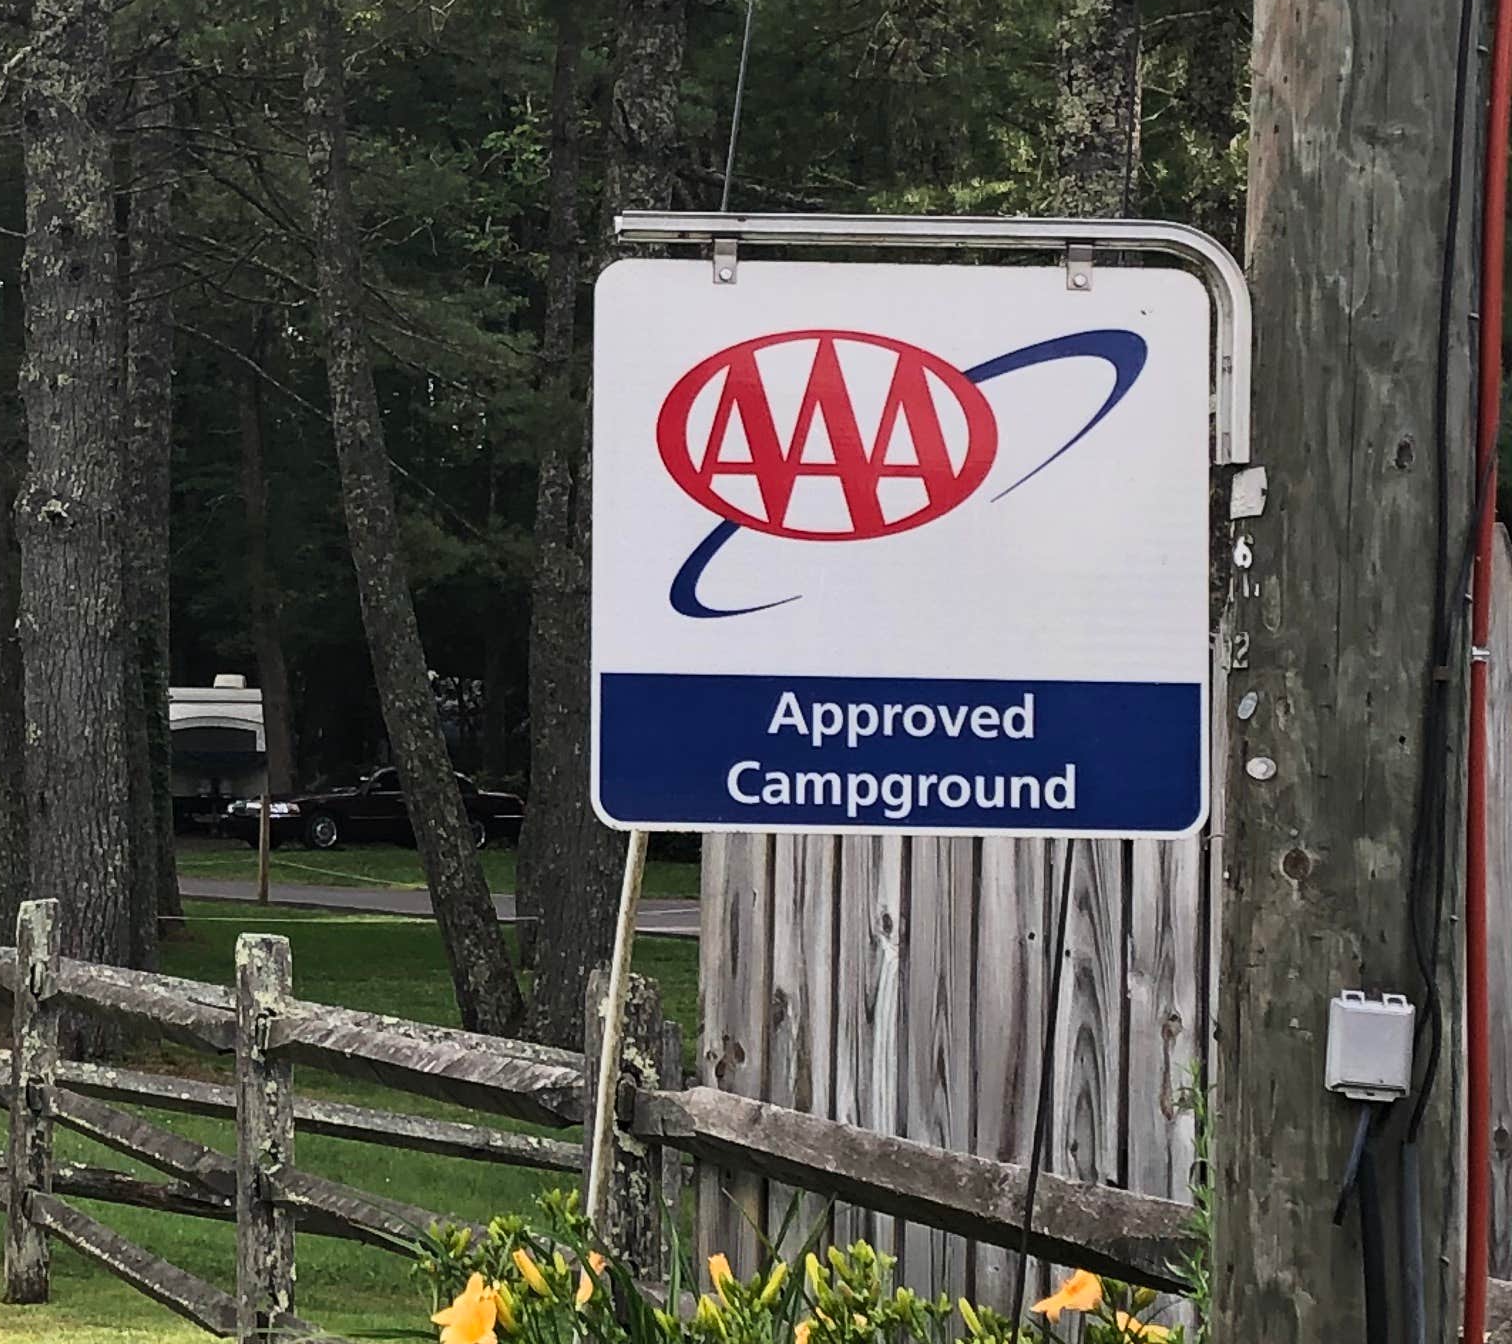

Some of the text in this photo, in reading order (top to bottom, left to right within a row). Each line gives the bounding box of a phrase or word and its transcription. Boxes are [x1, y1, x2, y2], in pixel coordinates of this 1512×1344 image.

[678, 331, 973, 538] AAA
[1234, 534, 1254, 569] 6
[1233, 631, 1250, 669] 2
[767, 690, 1035, 748] Approved
[726, 759, 1077, 820] Campground
